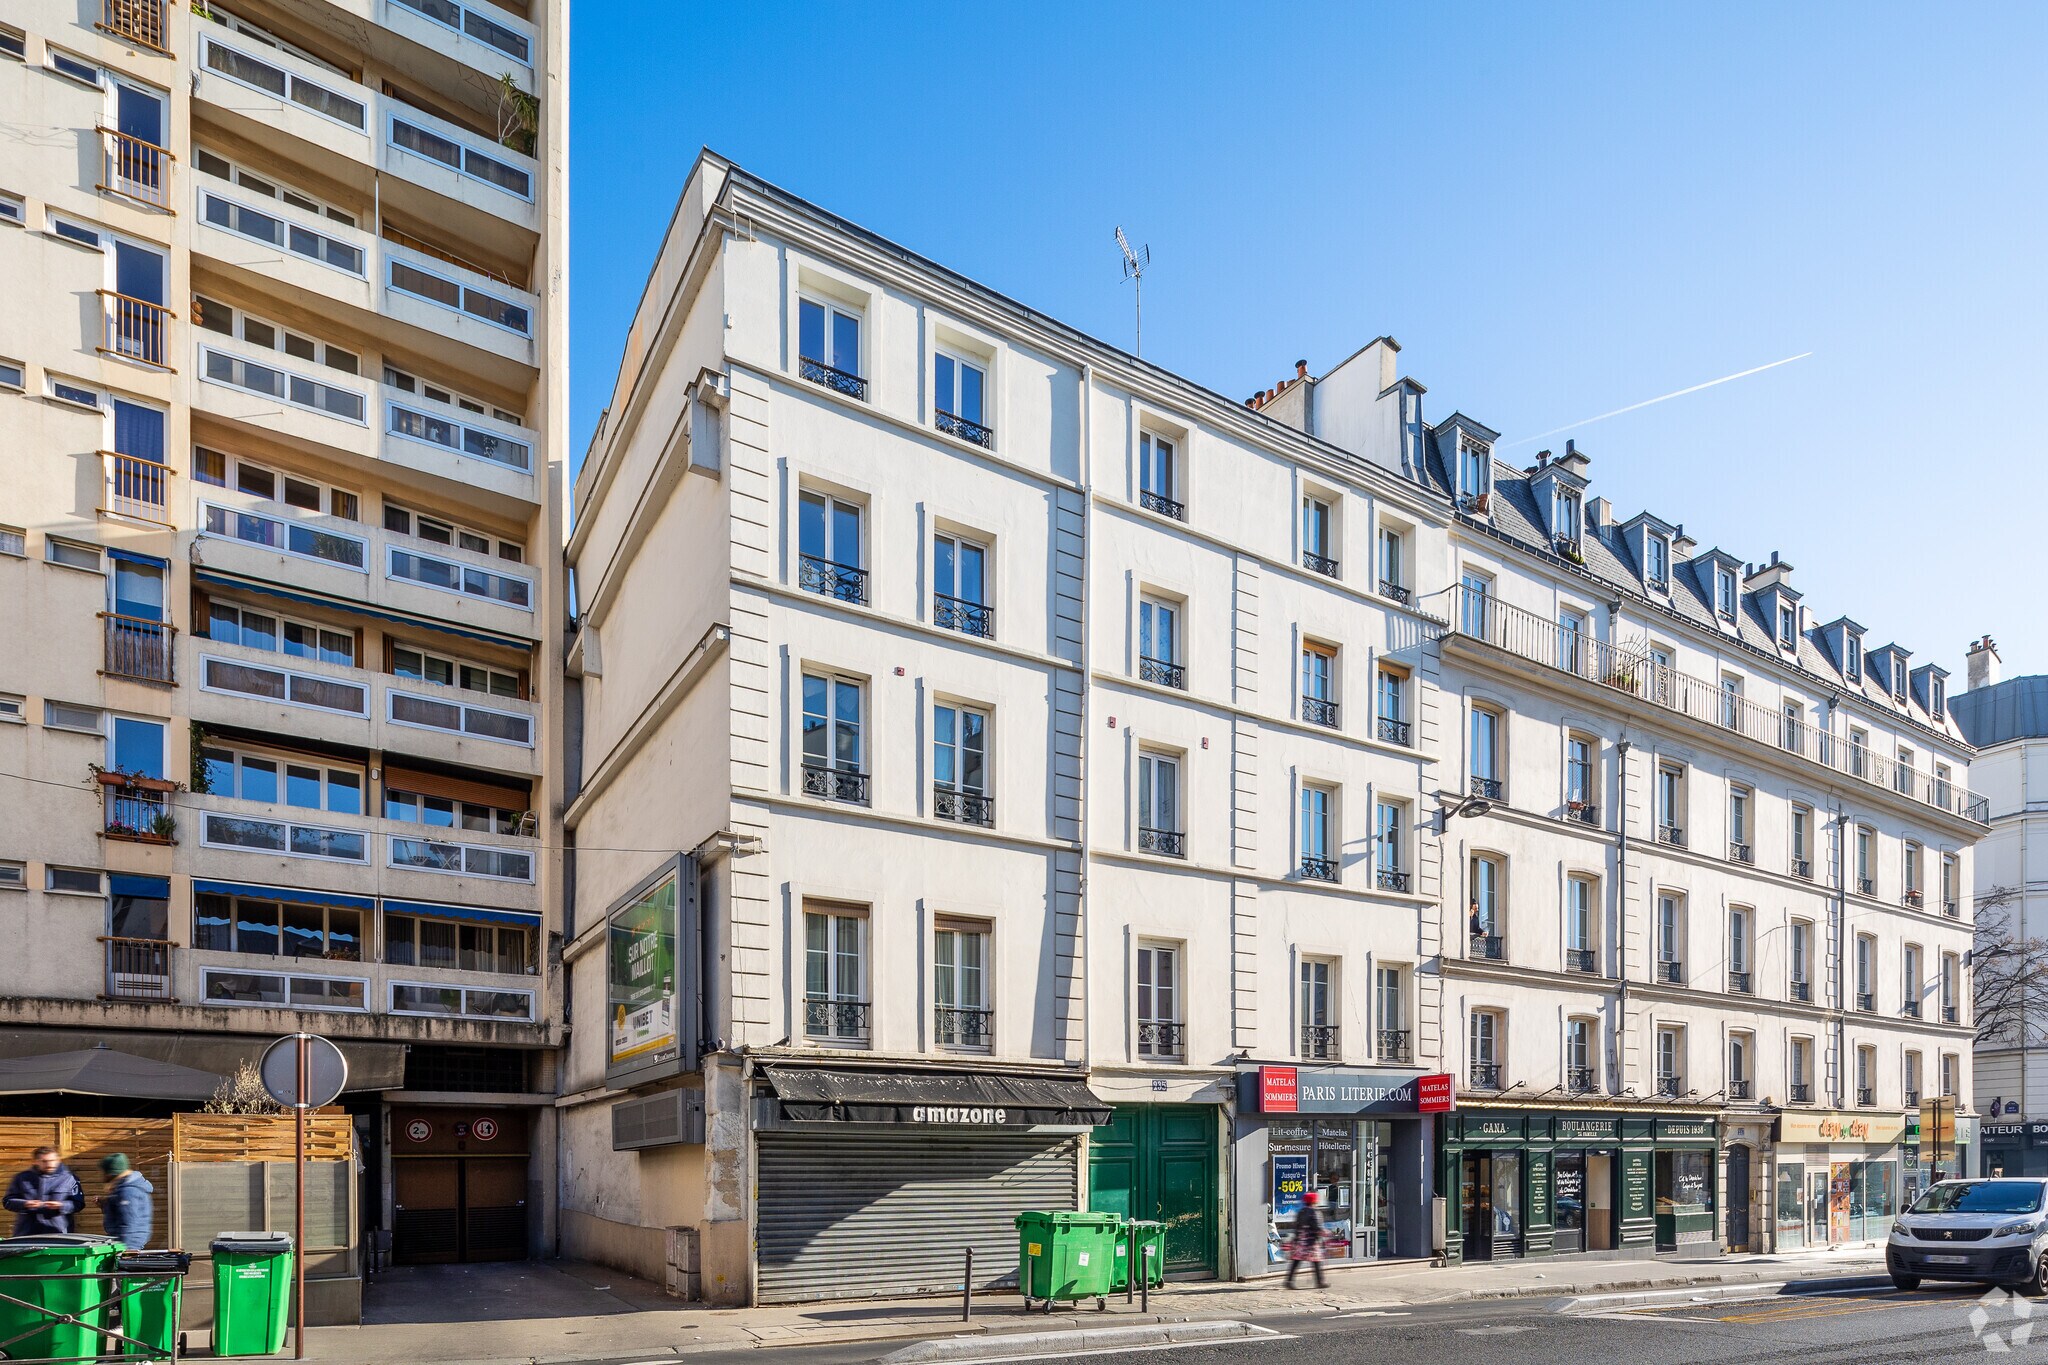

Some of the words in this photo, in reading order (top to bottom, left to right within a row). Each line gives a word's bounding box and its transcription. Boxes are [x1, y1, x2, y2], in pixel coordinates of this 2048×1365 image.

[628, 942, 640, 964] SUR
[639, 930, 658, 957] NOTRE
[631, 953, 655, 981] MAILLOT
[1266, 1077, 1296, 1087] MATELAS
[1421, 1083, 1449, 1092] MATELAS
[1264, 1092, 1297, 1102] SOMMIERS
[1302, 1086, 1336, 1101] PARIS
[1341, 1087, 1412, 1102] LITERIE.COM
[1419, 1095, 1450, 1104] SOMMIERS
[912, 1105, 1007, 1124] amazone
[1482, 1122, 1506, 1133] GANA
[1561, 1120, 1613, 1132] BOULANGERIE
[1667, 1125, 1690, 1135] DEPUIS
[1272, 1127, 1308, 1136] Lit-coffre
[1322, 1128, 1348, 1137] Matelas
[1268, 1142, 1312, 1152] Sur-mesure
[1318, 1142, 1351, 1151] Hôtellerie
[1278, 1180, 1304, 1193] -50%
